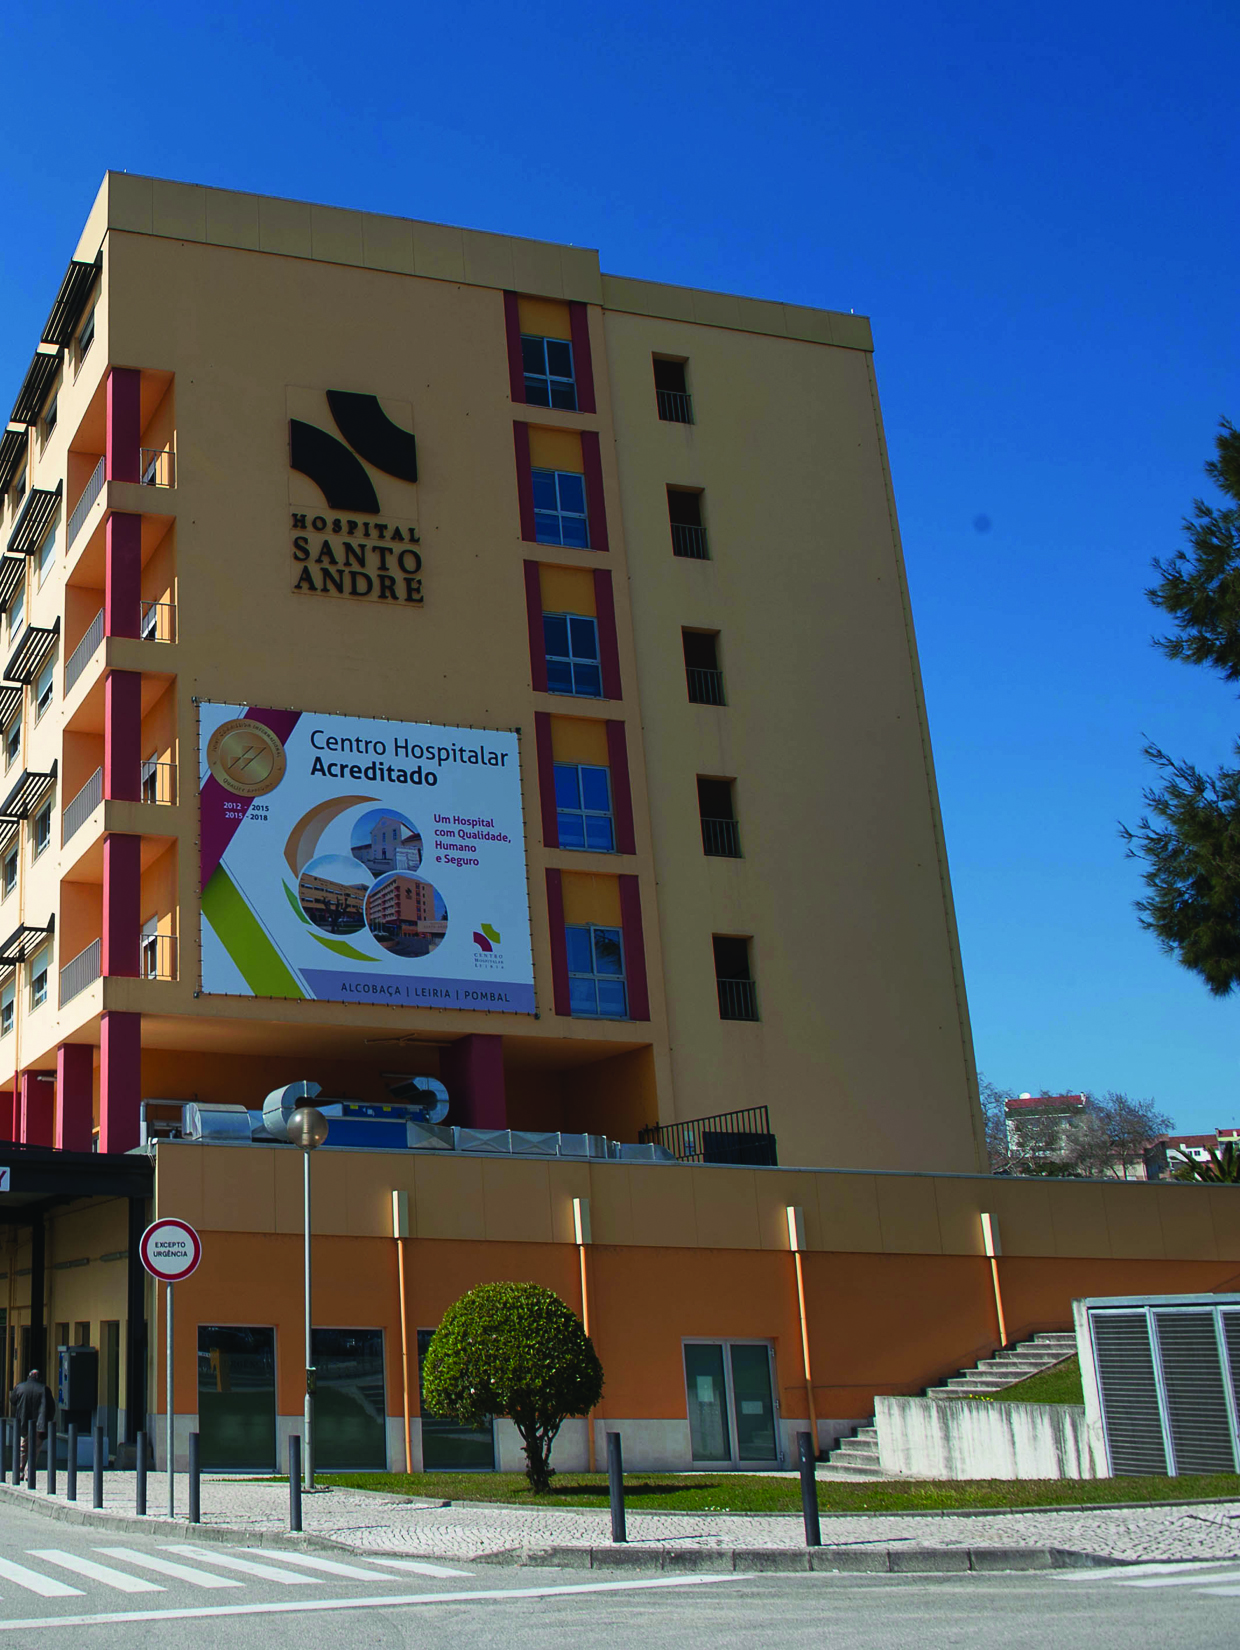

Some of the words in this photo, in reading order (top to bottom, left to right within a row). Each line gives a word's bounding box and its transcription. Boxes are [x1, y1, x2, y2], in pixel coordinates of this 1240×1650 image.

[291, 513, 421, 543] HOSPITAL
[293, 536, 422, 574] SANTO
[310, 730, 387, 756] Centro
[394, 737, 509, 767] Hospitalar
[310, 756, 438, 786] Acreditado
[223, 801, 242, 810] 2012
[251, 804, 270, 812] 2015
[225, 811, 243, 819] 2015
[433, 813, 451, 825] Um
[452, 815, 495, 829] Hospital
[434, 829, 456, 838] com
[457, 829, 512, 844] Qualidade,
[435, 840, 477, 853] Humano
[435, 855, 442, 863] e
[444, 854, 480, 868] Seguro
[341, 982, 402, 997] ALCOBAÇA
[414, 987, 451, 999] LEIRIA
[464, 990, 511, 1003] POMBAL
[153, 1249, 188, 1258] URGÊNCIA
